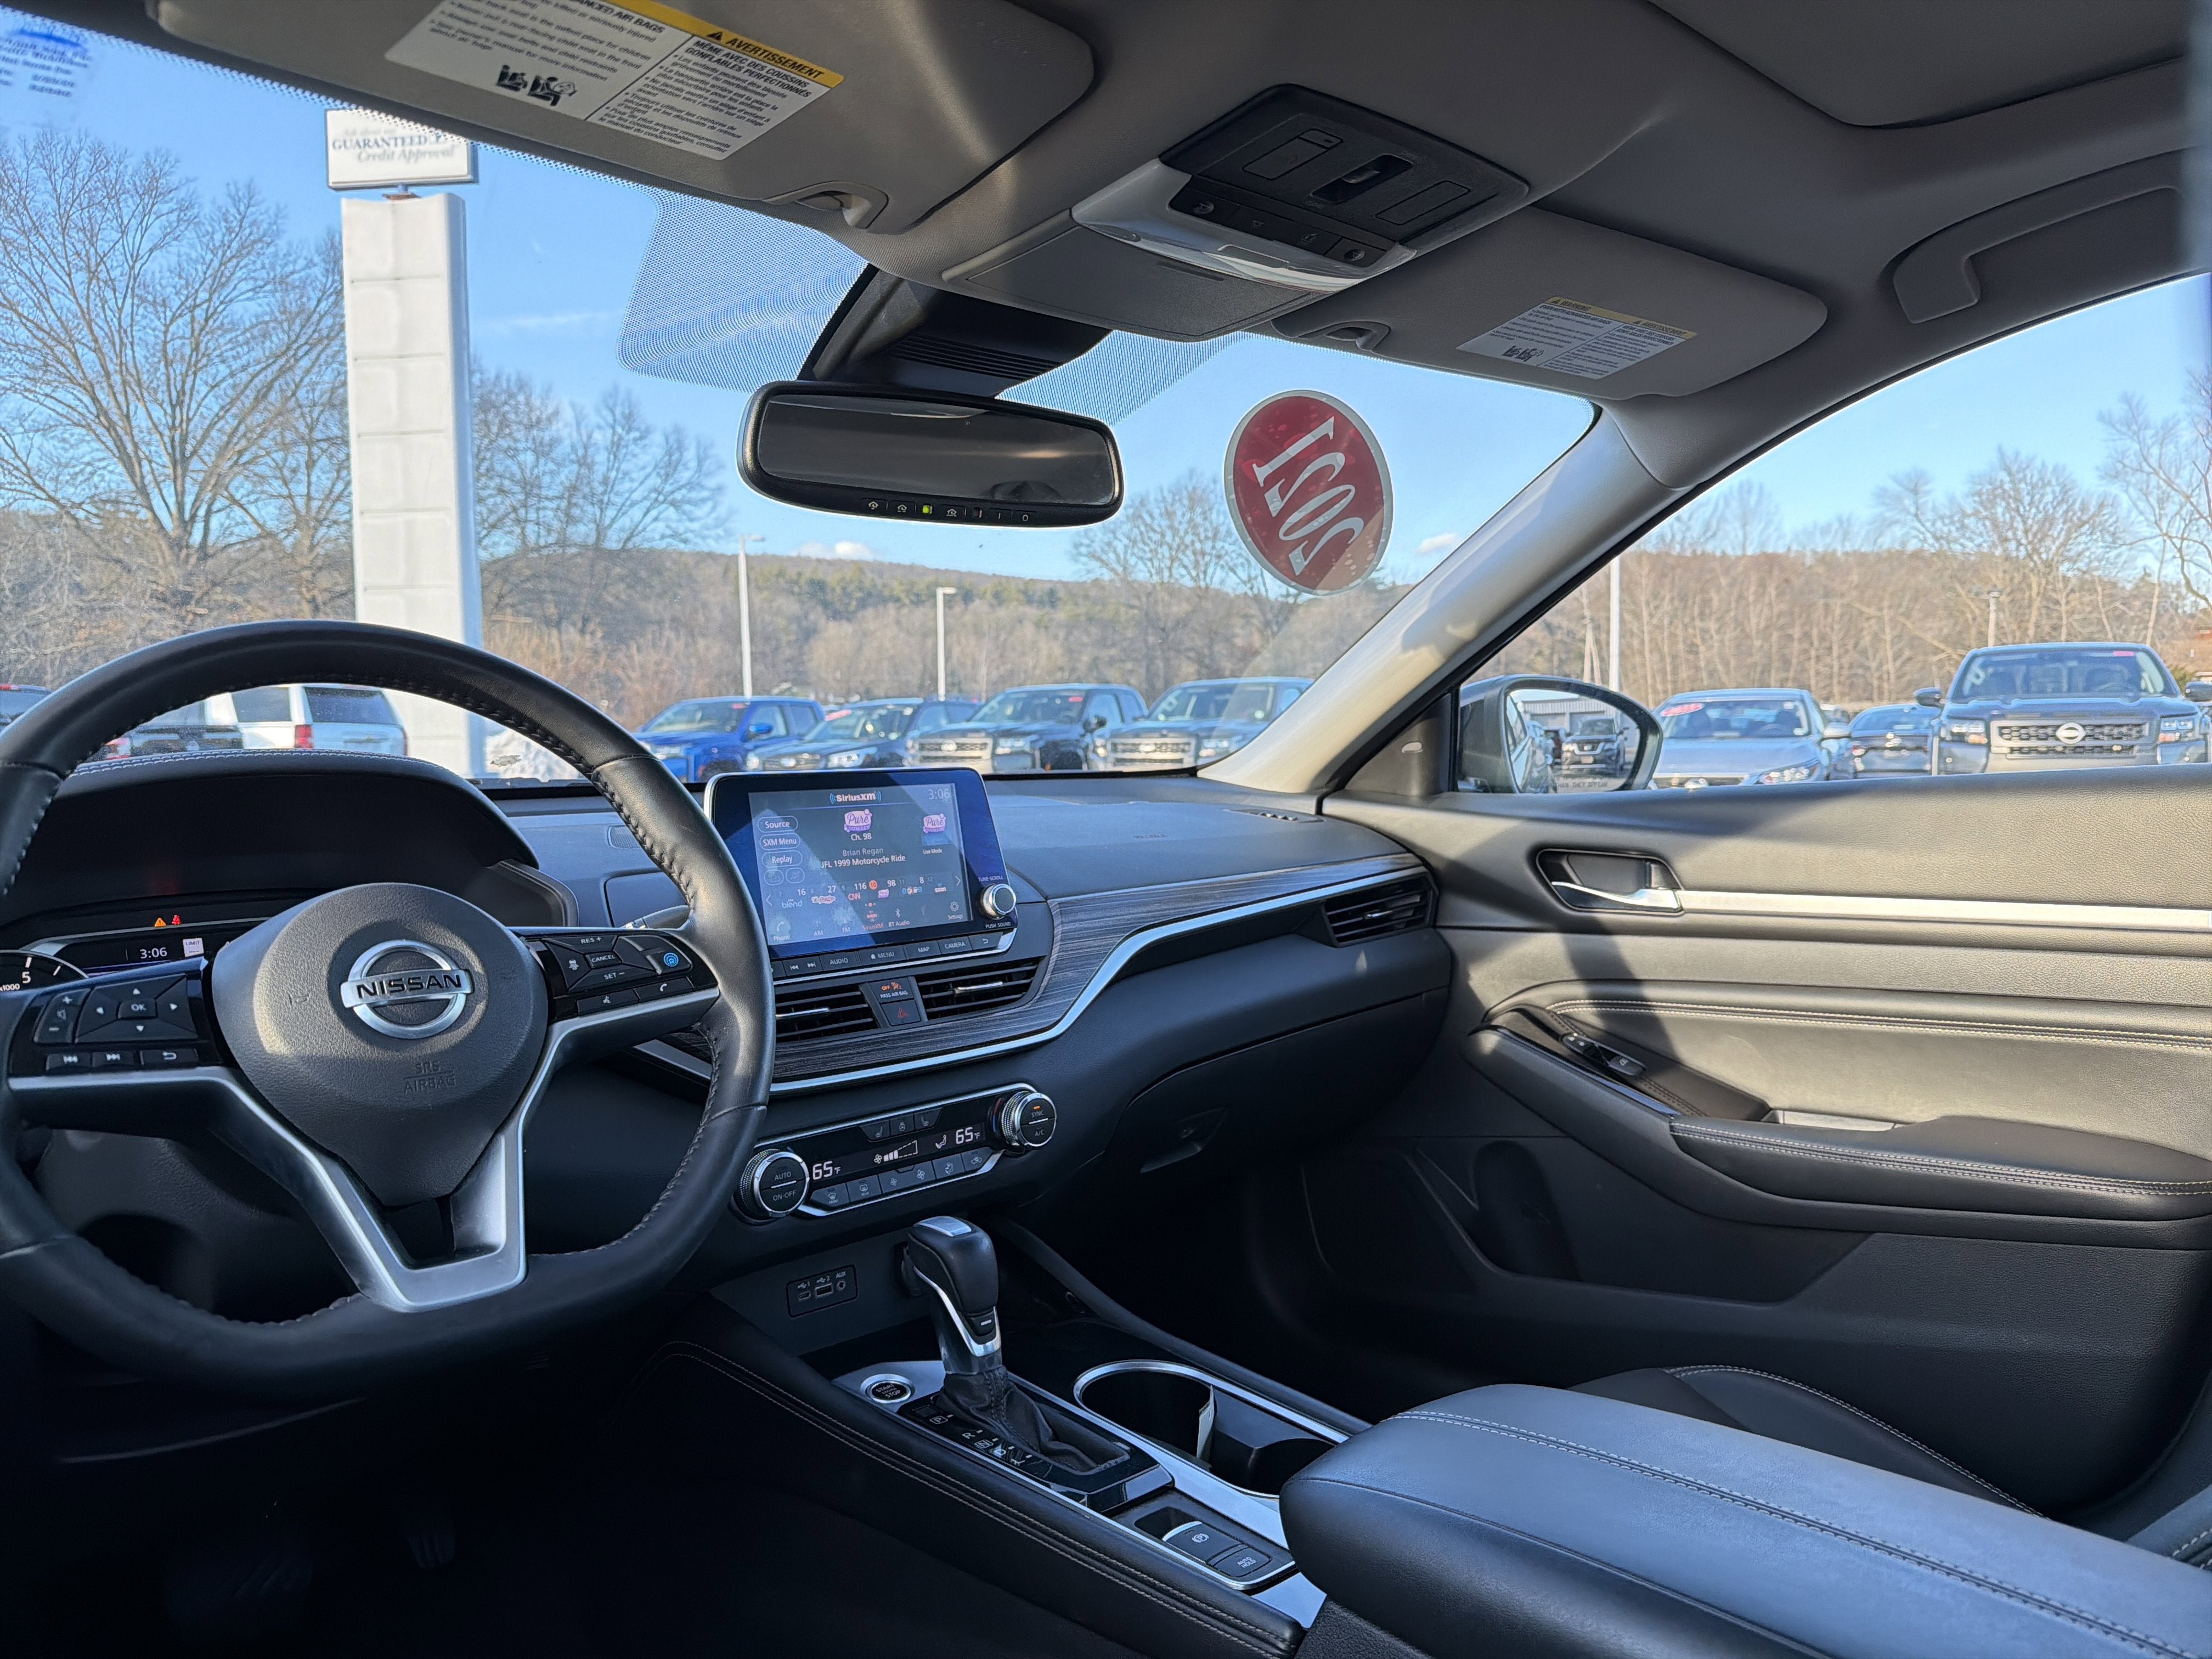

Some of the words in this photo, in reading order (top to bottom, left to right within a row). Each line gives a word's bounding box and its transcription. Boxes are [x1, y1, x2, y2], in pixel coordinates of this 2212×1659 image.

[614, 11, 635, 21] AIR
[634, 18, 665, 33] BAGS
[725, 37, 825, 78] AVERTISSEMENT
[692, 40, 726, 55] MÊME
[721, 52, 749, 64] AVEC
[746, 61, 768, 71] DES
[764, 68, 810, 87] COUSSINS
[684, 47, 745, 71] GONFLABLES
[741, 68, 813, 97] PERFECTIONNÉS
[332, 134, 427, 150] GUARANTEED
[358, 149, 395, 162] Credit
[398, 145, 454, 163] Approval
[928, 788, 951, 799] 3:06
[847, 813, 870, 824] Pure
[926, 817, 944, 827] Pure
[765, 821, 790, 829] Source
[862, 848, 884, 856] Regan
[771, 855, 793, 864] Replay
[821, 860, 832, 868] JFL
[834, 859, 851, 867] 1999
[852, 856, 890, 866] Motorcycle
[854, 882, 867, 890] 116
[848, 892, 861, 900] CNN
[781, 900, 803, 909] blend
[139, 947, 167, 959] 3:06
[591, 954, 616, 963] CANCEL
[22, 971, 31, 984] 5
[357, 974, 462, 1000] NISSAN
[415, 1060, 441, 1074] SRS
[404, 1074, 456, 1094] AIRBAG
[774, 1171, 792, 1181] AUTO
[876, 1384, 895, 1393] START
[885, 1390, 901, 1398] STOP
[1237, 1556, 1252, 1566] AUTO
[1241, 1560, 1256, 1568] HOLD
